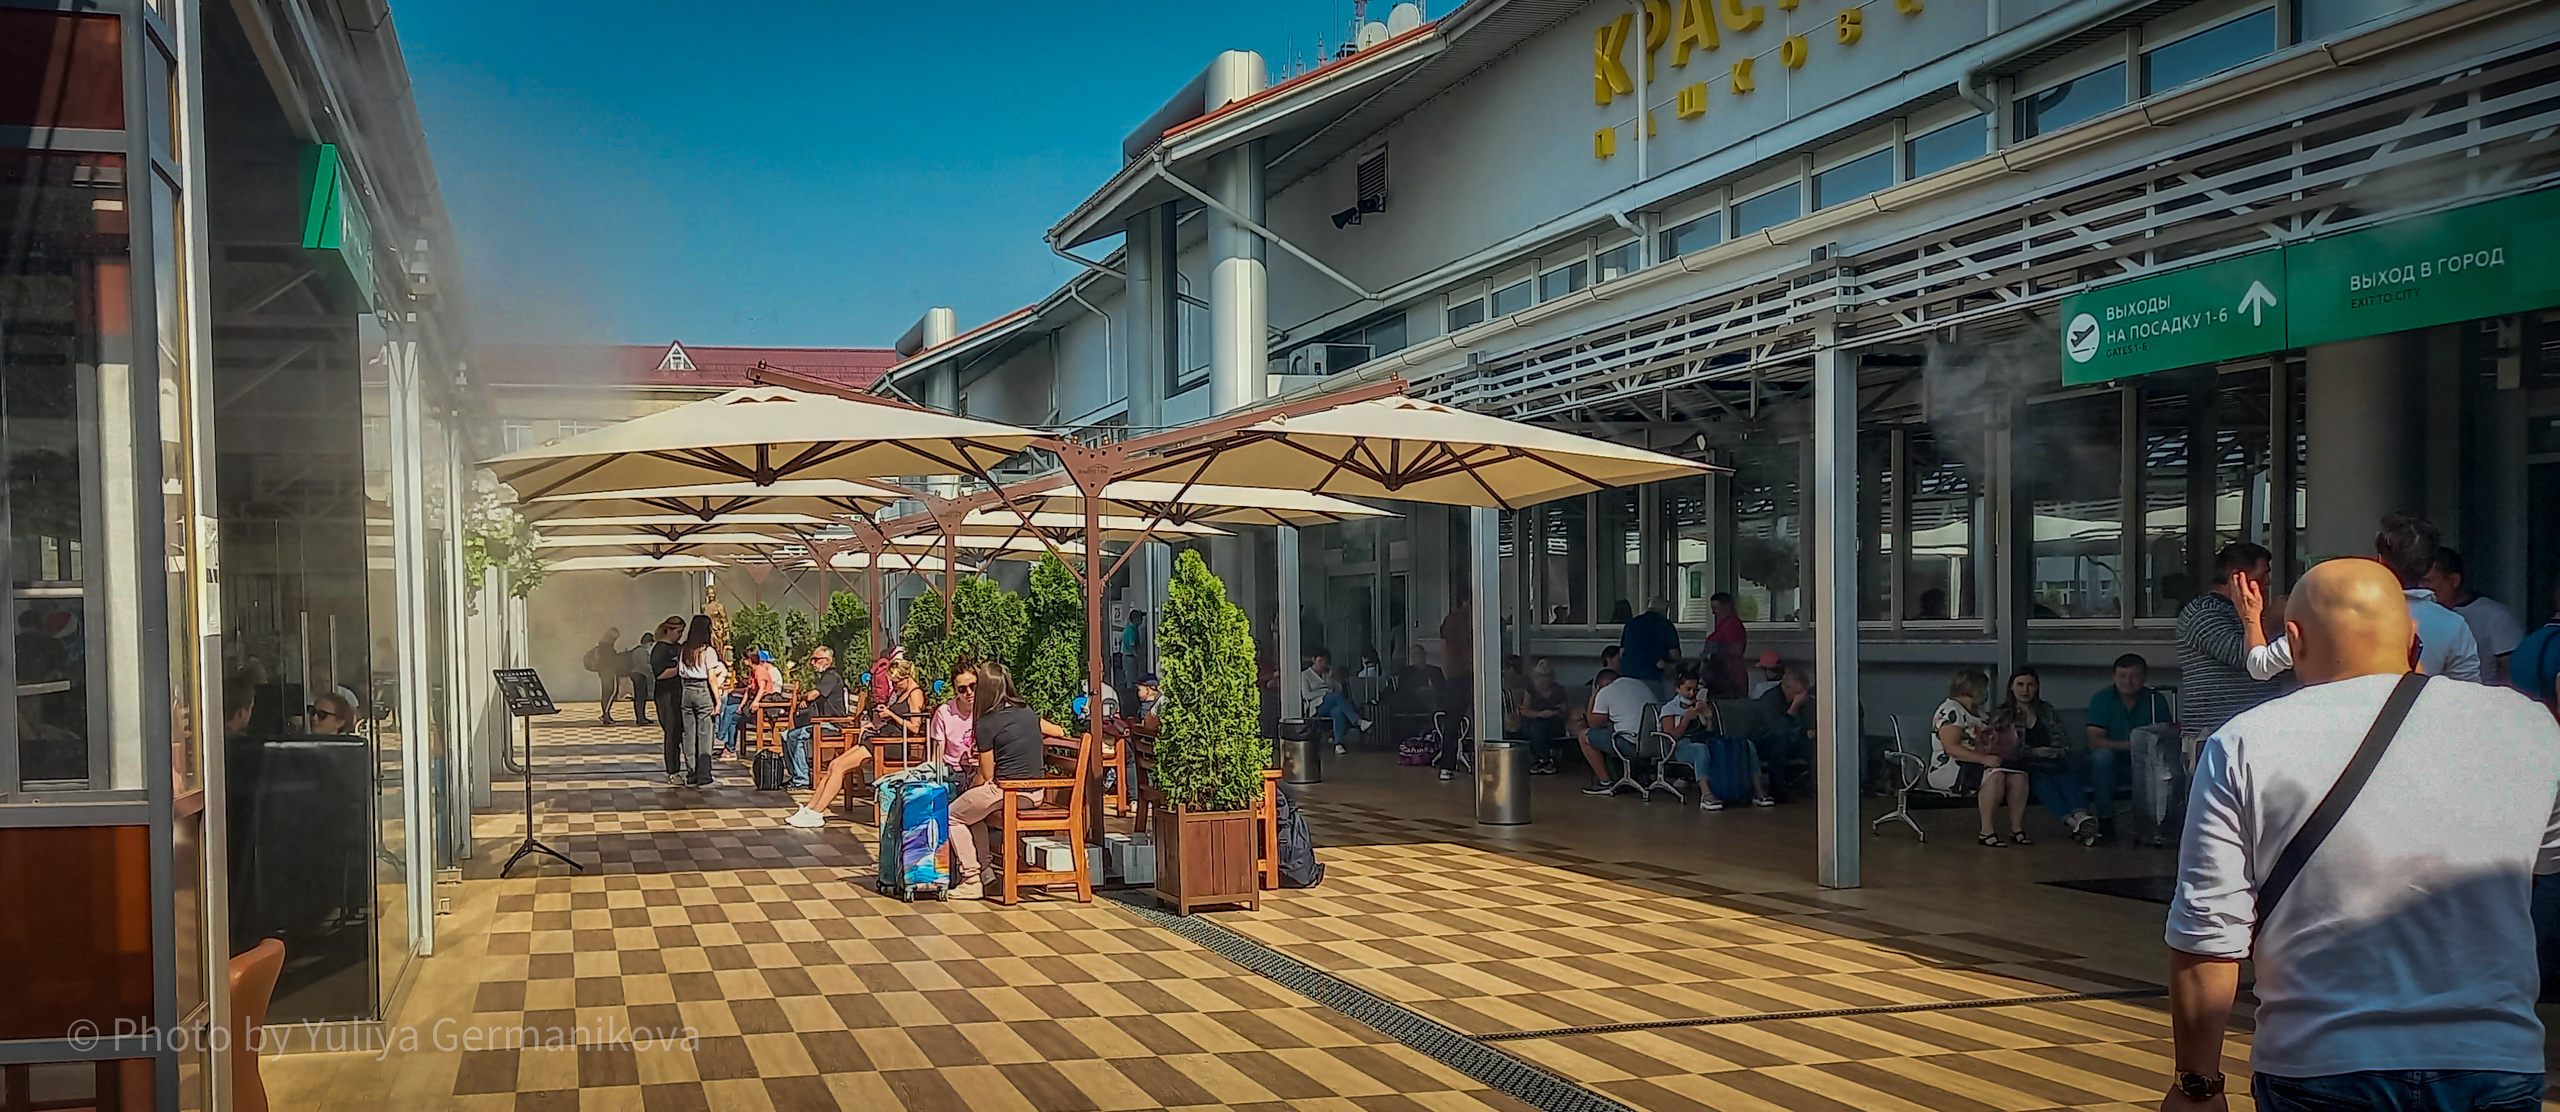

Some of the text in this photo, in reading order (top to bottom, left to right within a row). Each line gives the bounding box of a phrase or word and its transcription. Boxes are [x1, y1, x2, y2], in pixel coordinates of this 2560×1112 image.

[1594, 0, 1799, 105] КРА
[2350, 247, 2505, 291] ВЫХОД В ГОРОД
[2106, 295, 2171, 321] ВЫХОДЫ
[2351, 287, 2421, 309] EXIT TO CITY
[2107, 307, 2228, 344] НА ПОСАДКУ 1-6
[2106, 342, 2148, 358] GATES 1-6
